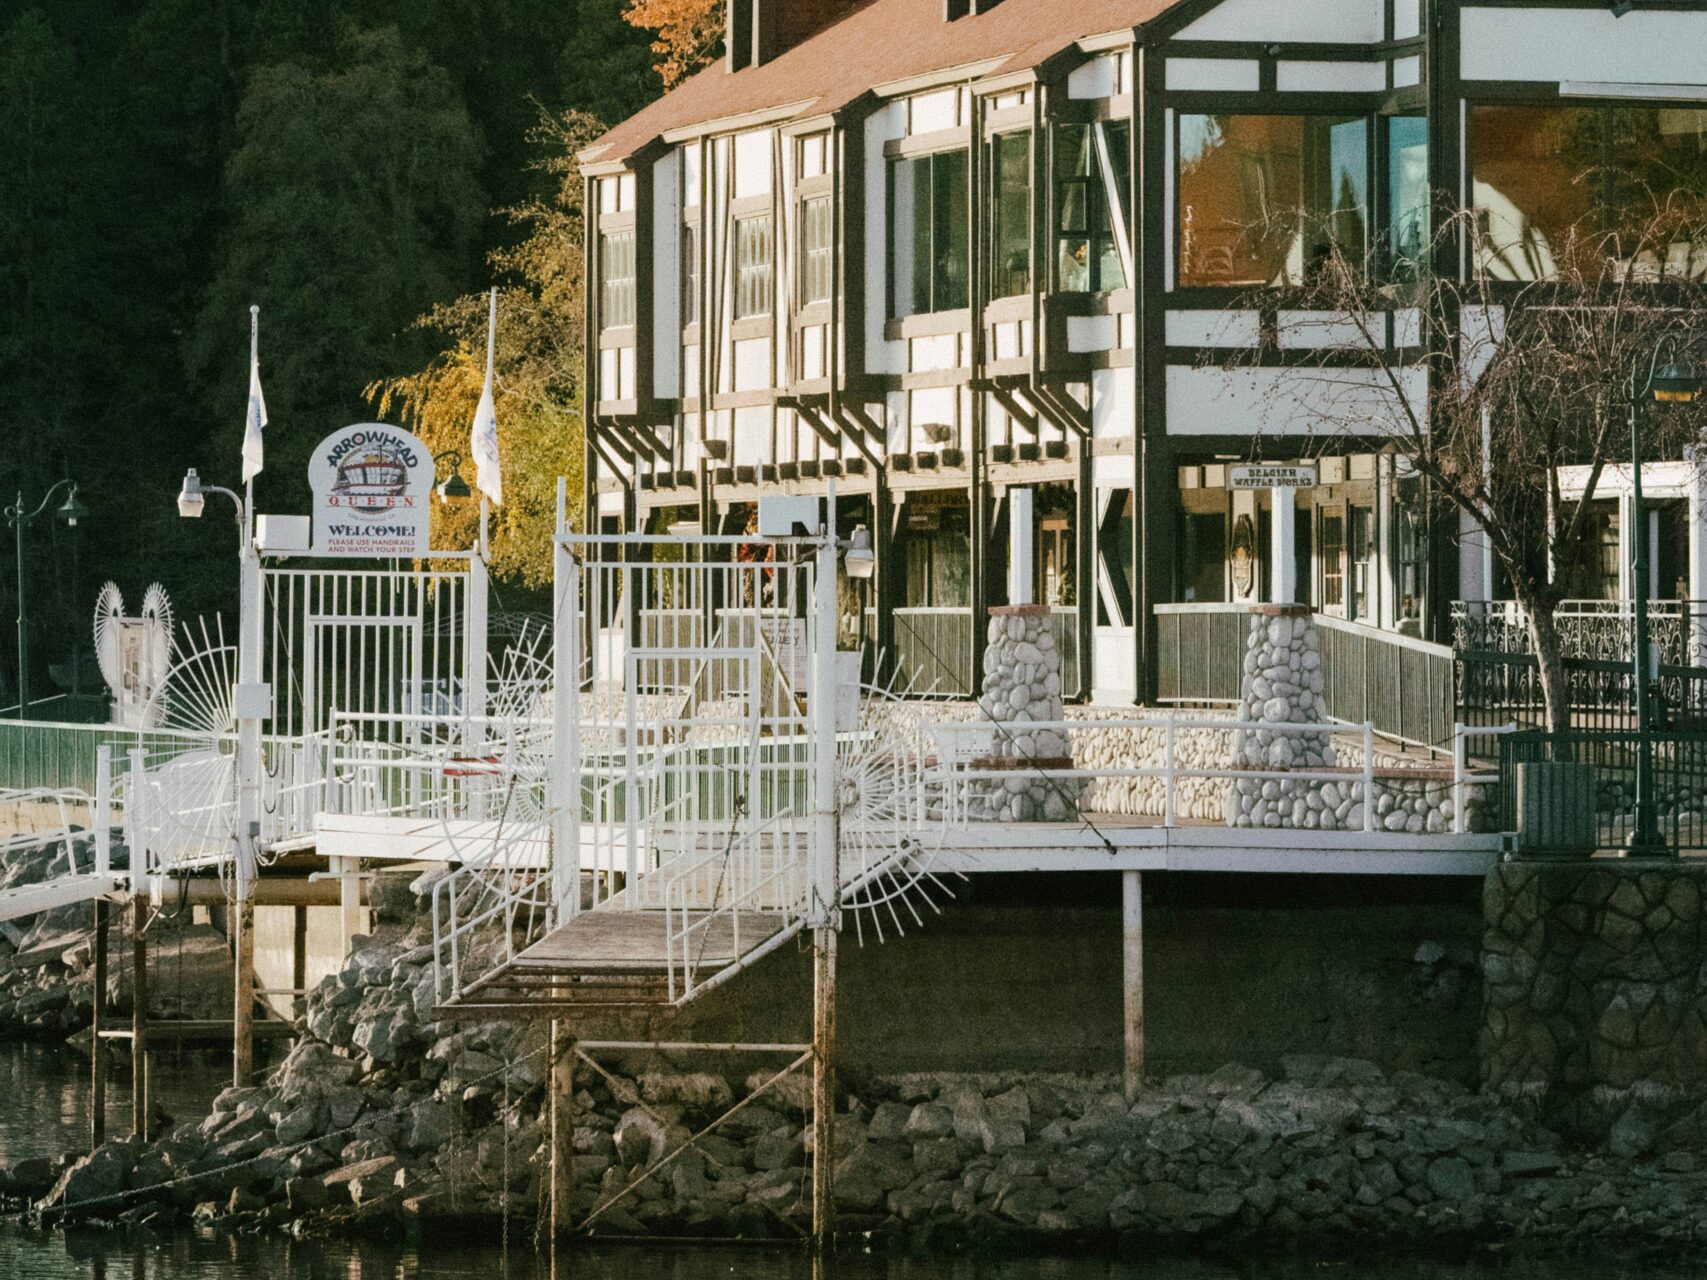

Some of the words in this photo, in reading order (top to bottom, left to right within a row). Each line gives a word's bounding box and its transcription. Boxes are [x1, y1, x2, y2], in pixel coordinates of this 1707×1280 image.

[326, 430, 419, 468] ARROWHEAD
[1248, 468, 1297, 477] BELGIAN
[1234, 478, 1274, 487] WAFFLE
[1277, 477, 1313, 487] WORKS
[328, 525, 416, 537] WELCOME!
